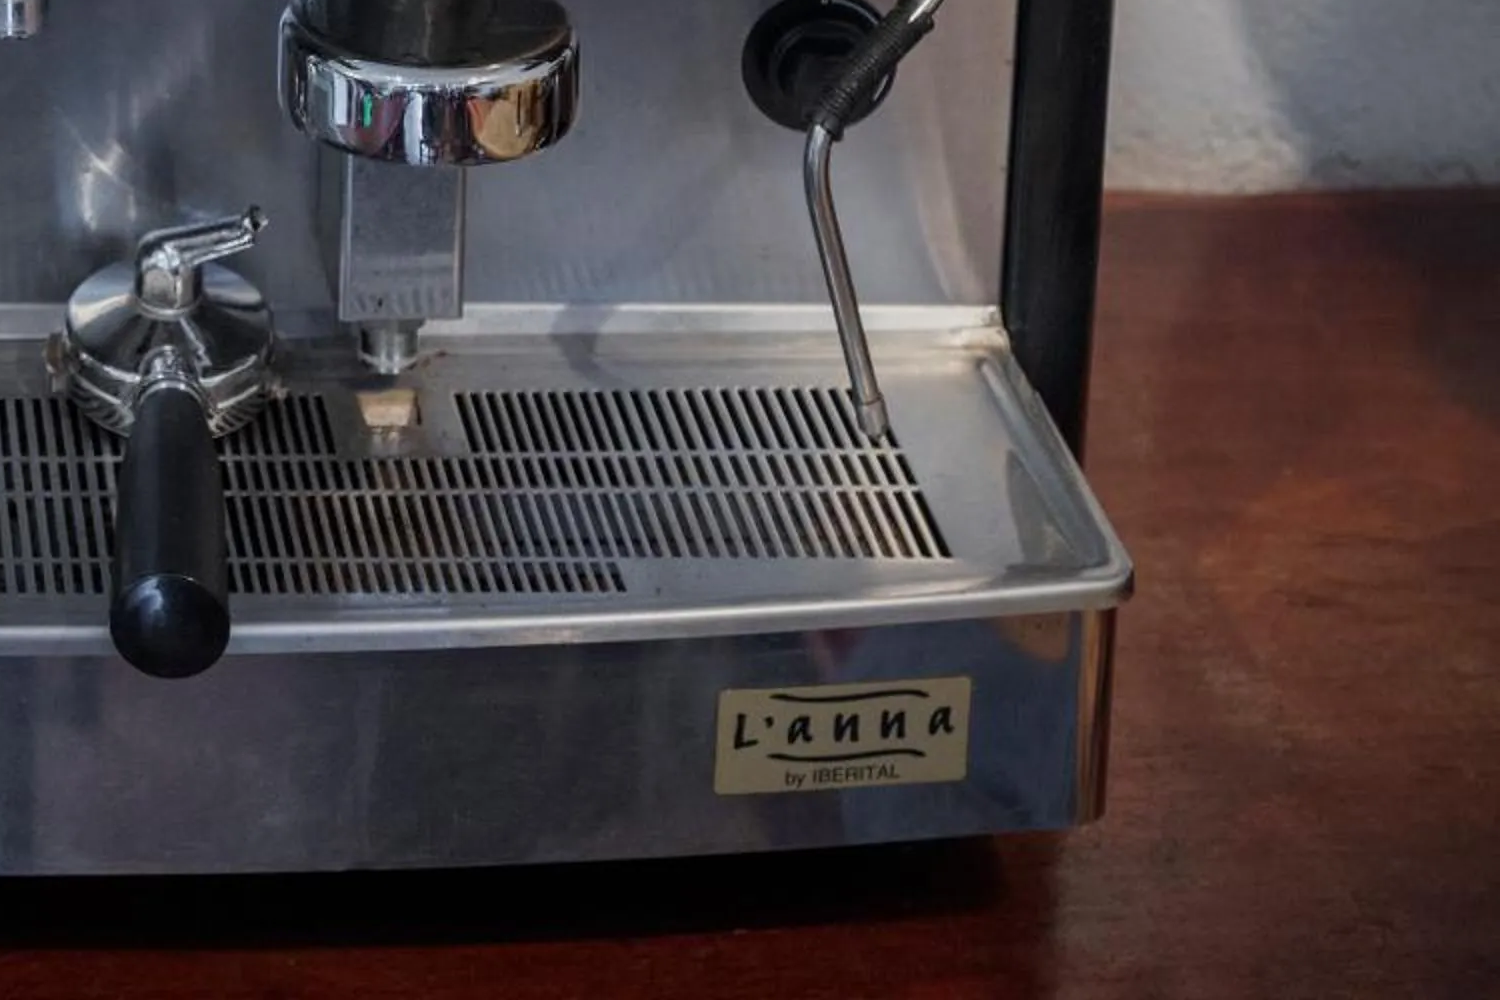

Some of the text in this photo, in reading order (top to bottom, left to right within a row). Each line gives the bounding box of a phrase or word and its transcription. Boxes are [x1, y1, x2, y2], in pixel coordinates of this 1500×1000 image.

[733, 705, 955, 750] L'anna
[784, 763, 901, 787] by IBERITAL
